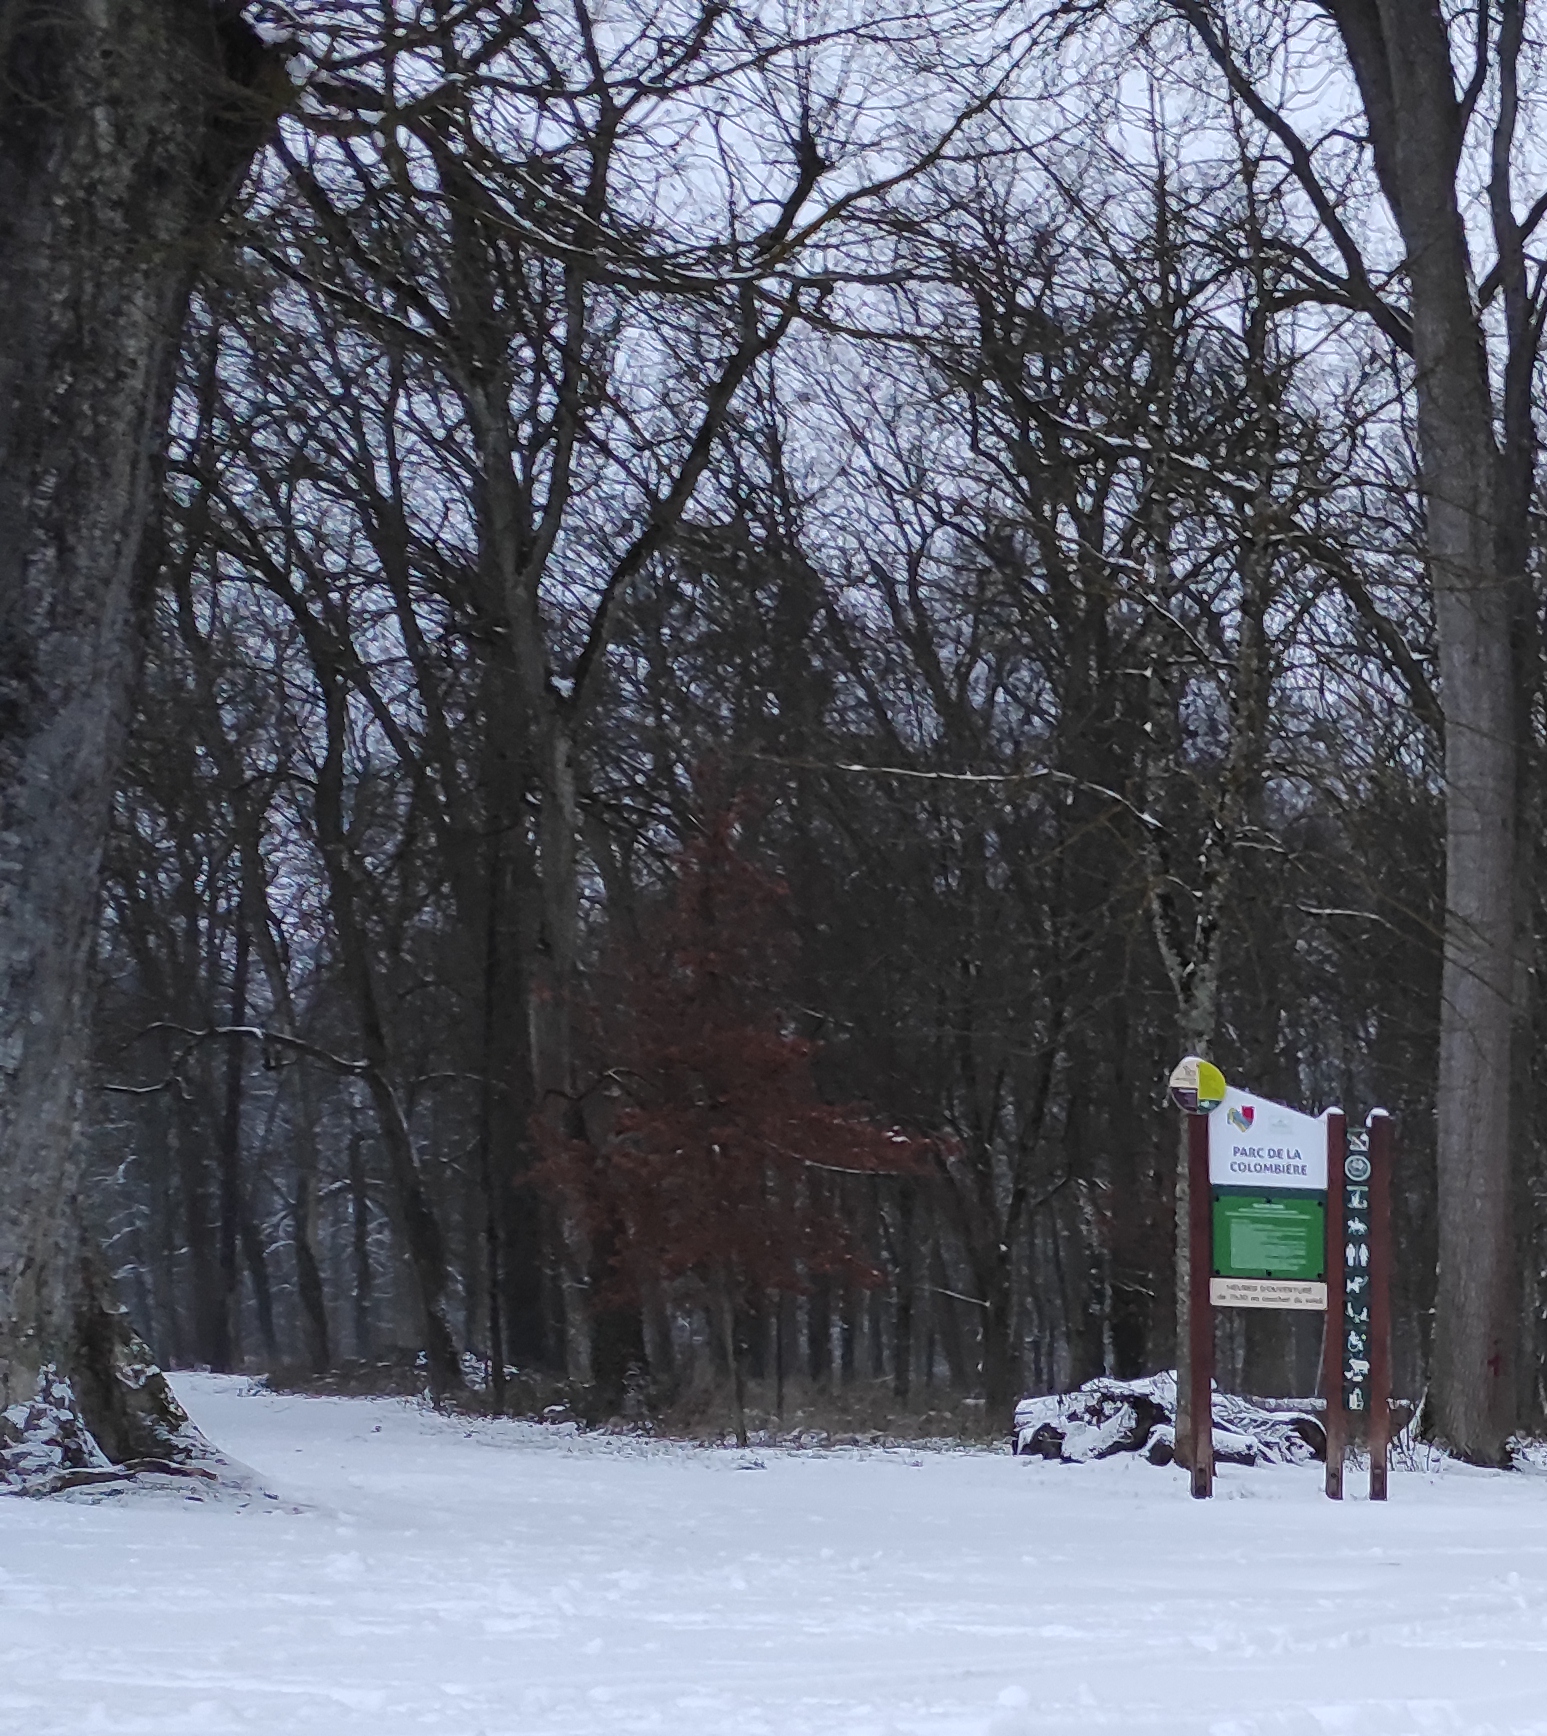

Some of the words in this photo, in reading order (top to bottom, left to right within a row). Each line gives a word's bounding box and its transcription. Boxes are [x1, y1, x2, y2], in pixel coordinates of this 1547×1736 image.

[1233, 1146, 1265, 1159] PARC
[1267, 1148, 1284, 1160] DE
[1286, 1148, 1302, 1160] LA
